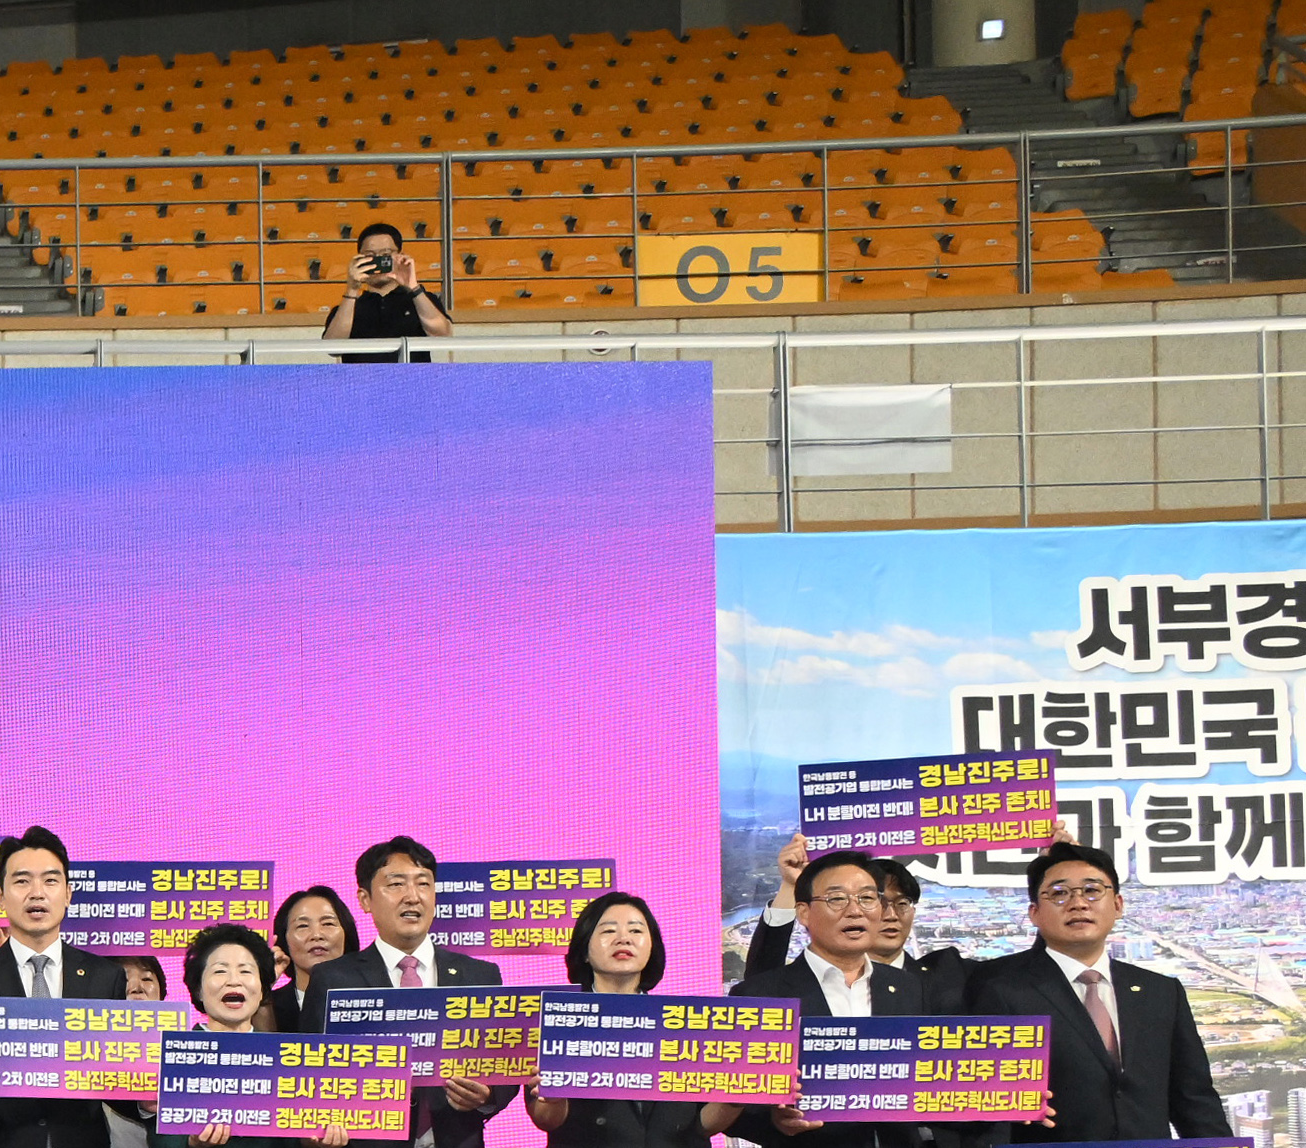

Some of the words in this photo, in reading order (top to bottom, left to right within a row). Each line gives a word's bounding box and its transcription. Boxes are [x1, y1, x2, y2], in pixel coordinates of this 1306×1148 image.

[961, 688, 1279, 770] 대한민국
[802, 780, 857, 796] 발전공기업
[858, 777, 914, 793] 통합본사는
[918, 756, 1049, 788] 경남진주로!
[803, 805, 825, 823] LH
[826, 801, 881, 821] 분할이전
[881, 800, 914, 818] 반대!
[918, 794, 959, 818] 본사
[961, 791, 1002, 815] 진주
[1005, 788, 1051, 813] 존치!
[802, 832, 853, 852] 공공기관
[853, 831, 878, 848] 2차
[877, 828, 916, 846] 이전은
[919, 818, 1052, 847] 경남진주혁신도시로!
[1144, 792, 1306, 874] 함께
[151, 868, 268, 891] 경남진주로!
[489, 866, 611, 891] 경남진주로!
[64, 1007, 186, 1032] 경남진주로!
[661, 1004, 793, 1031] 경남진주로!
[801, 1037, 857, 1051] 발전공기업
[856, 1037, 912, 1051] 통합본사는
[917, 1024, 1044, 1050] 경남진주로!
[279, 1041, 406, 1068] 경남진주로!
[658, 1038, 700, 1062] 본사
[702, 1039, 742, 1063] 진주
[746, 1040, 793, 1065] 존치!
[800, 1063, 822, 1080] LH
[823, 1062, 877, 1080] 분할이전
[878, 1062, 910, 1080] 반대!
[914, 1058, 954, 1082] 본사
[956, 1058, 995, 1082] 진주
[998, 1058, 1043, 1082] 존치!
[276, 1075, 316, 1099] 본사
[318, 1076, 358, 1100] 진주
[361, 1077, 406, 1101] 존치!
[797, 1093, 847, 1111] 공공기관
[846, 1093, 871, 1110] 2차
[870, 1093, 908, 1110] 이전은
[912, 1089, 1042, 1113] 경남진주혁신도시로!
